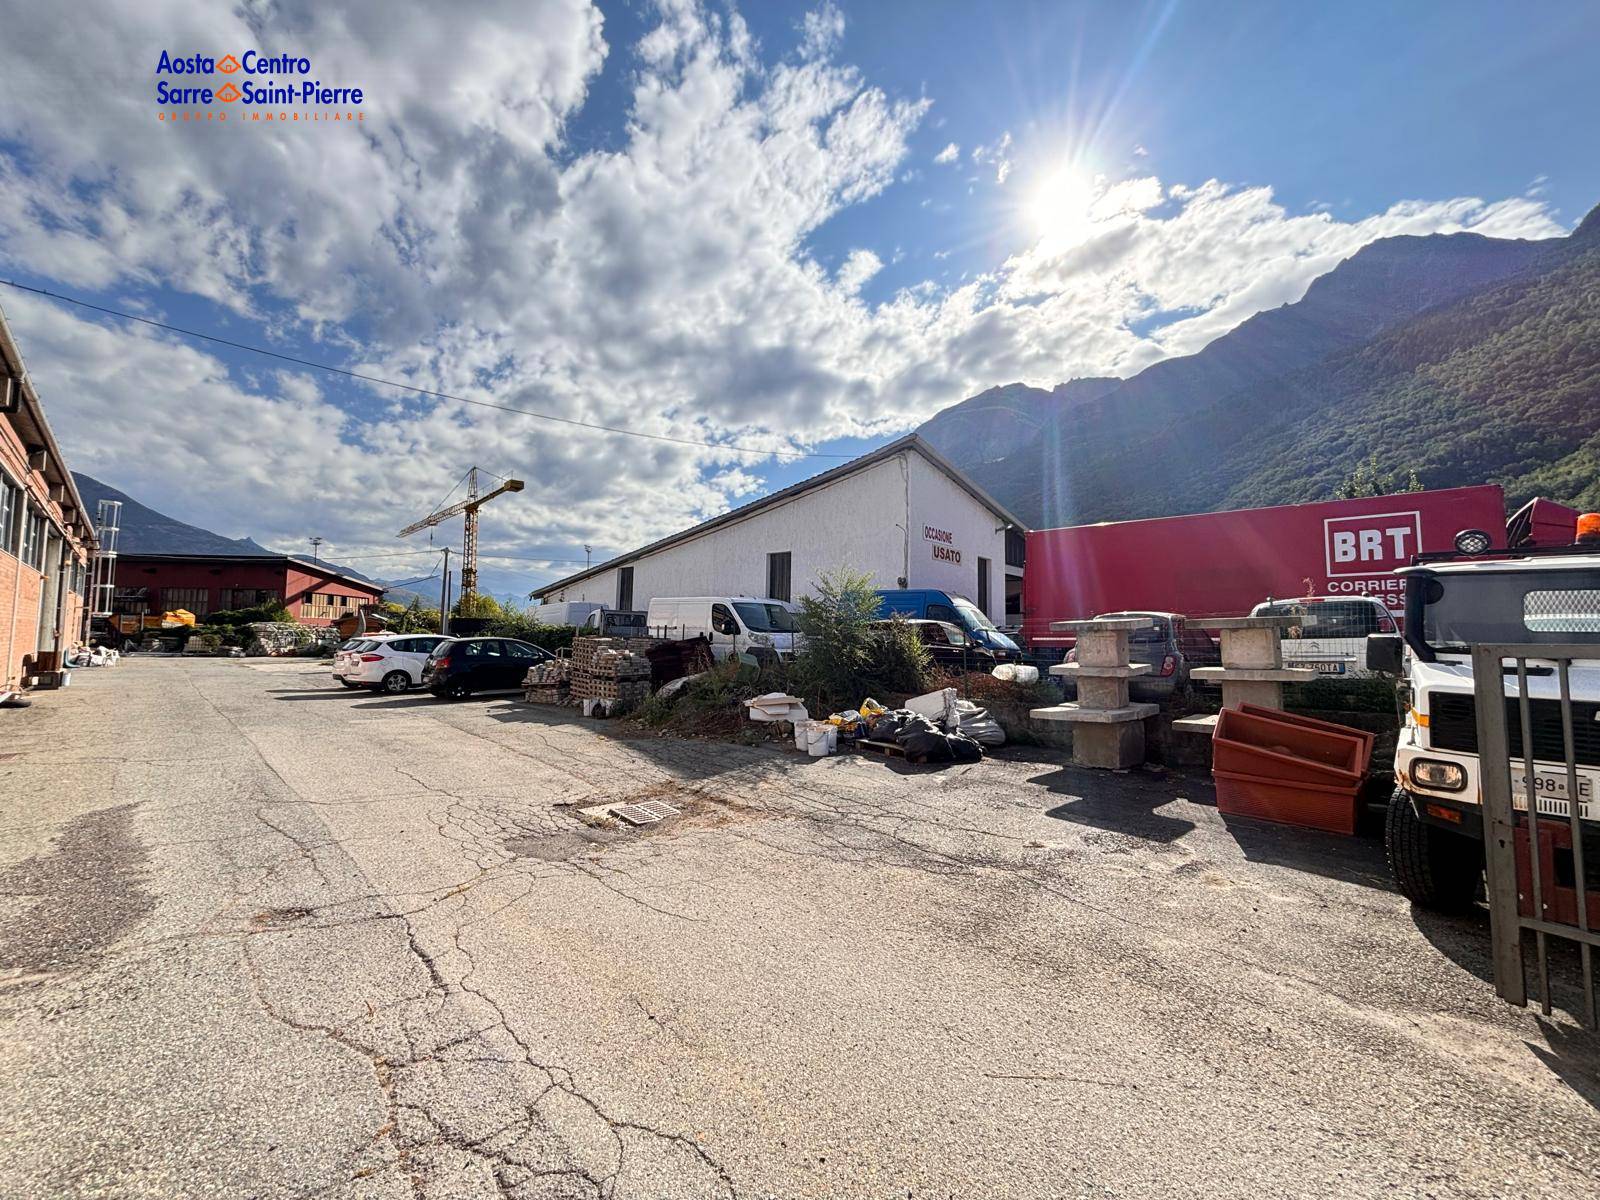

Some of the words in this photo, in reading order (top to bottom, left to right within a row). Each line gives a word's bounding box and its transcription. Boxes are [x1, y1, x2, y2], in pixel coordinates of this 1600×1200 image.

[925, 526, 952, 544] OCCASIONE
[934, 545, 961, 563] USATO
[1333, 527, 1411, 563] BRT
